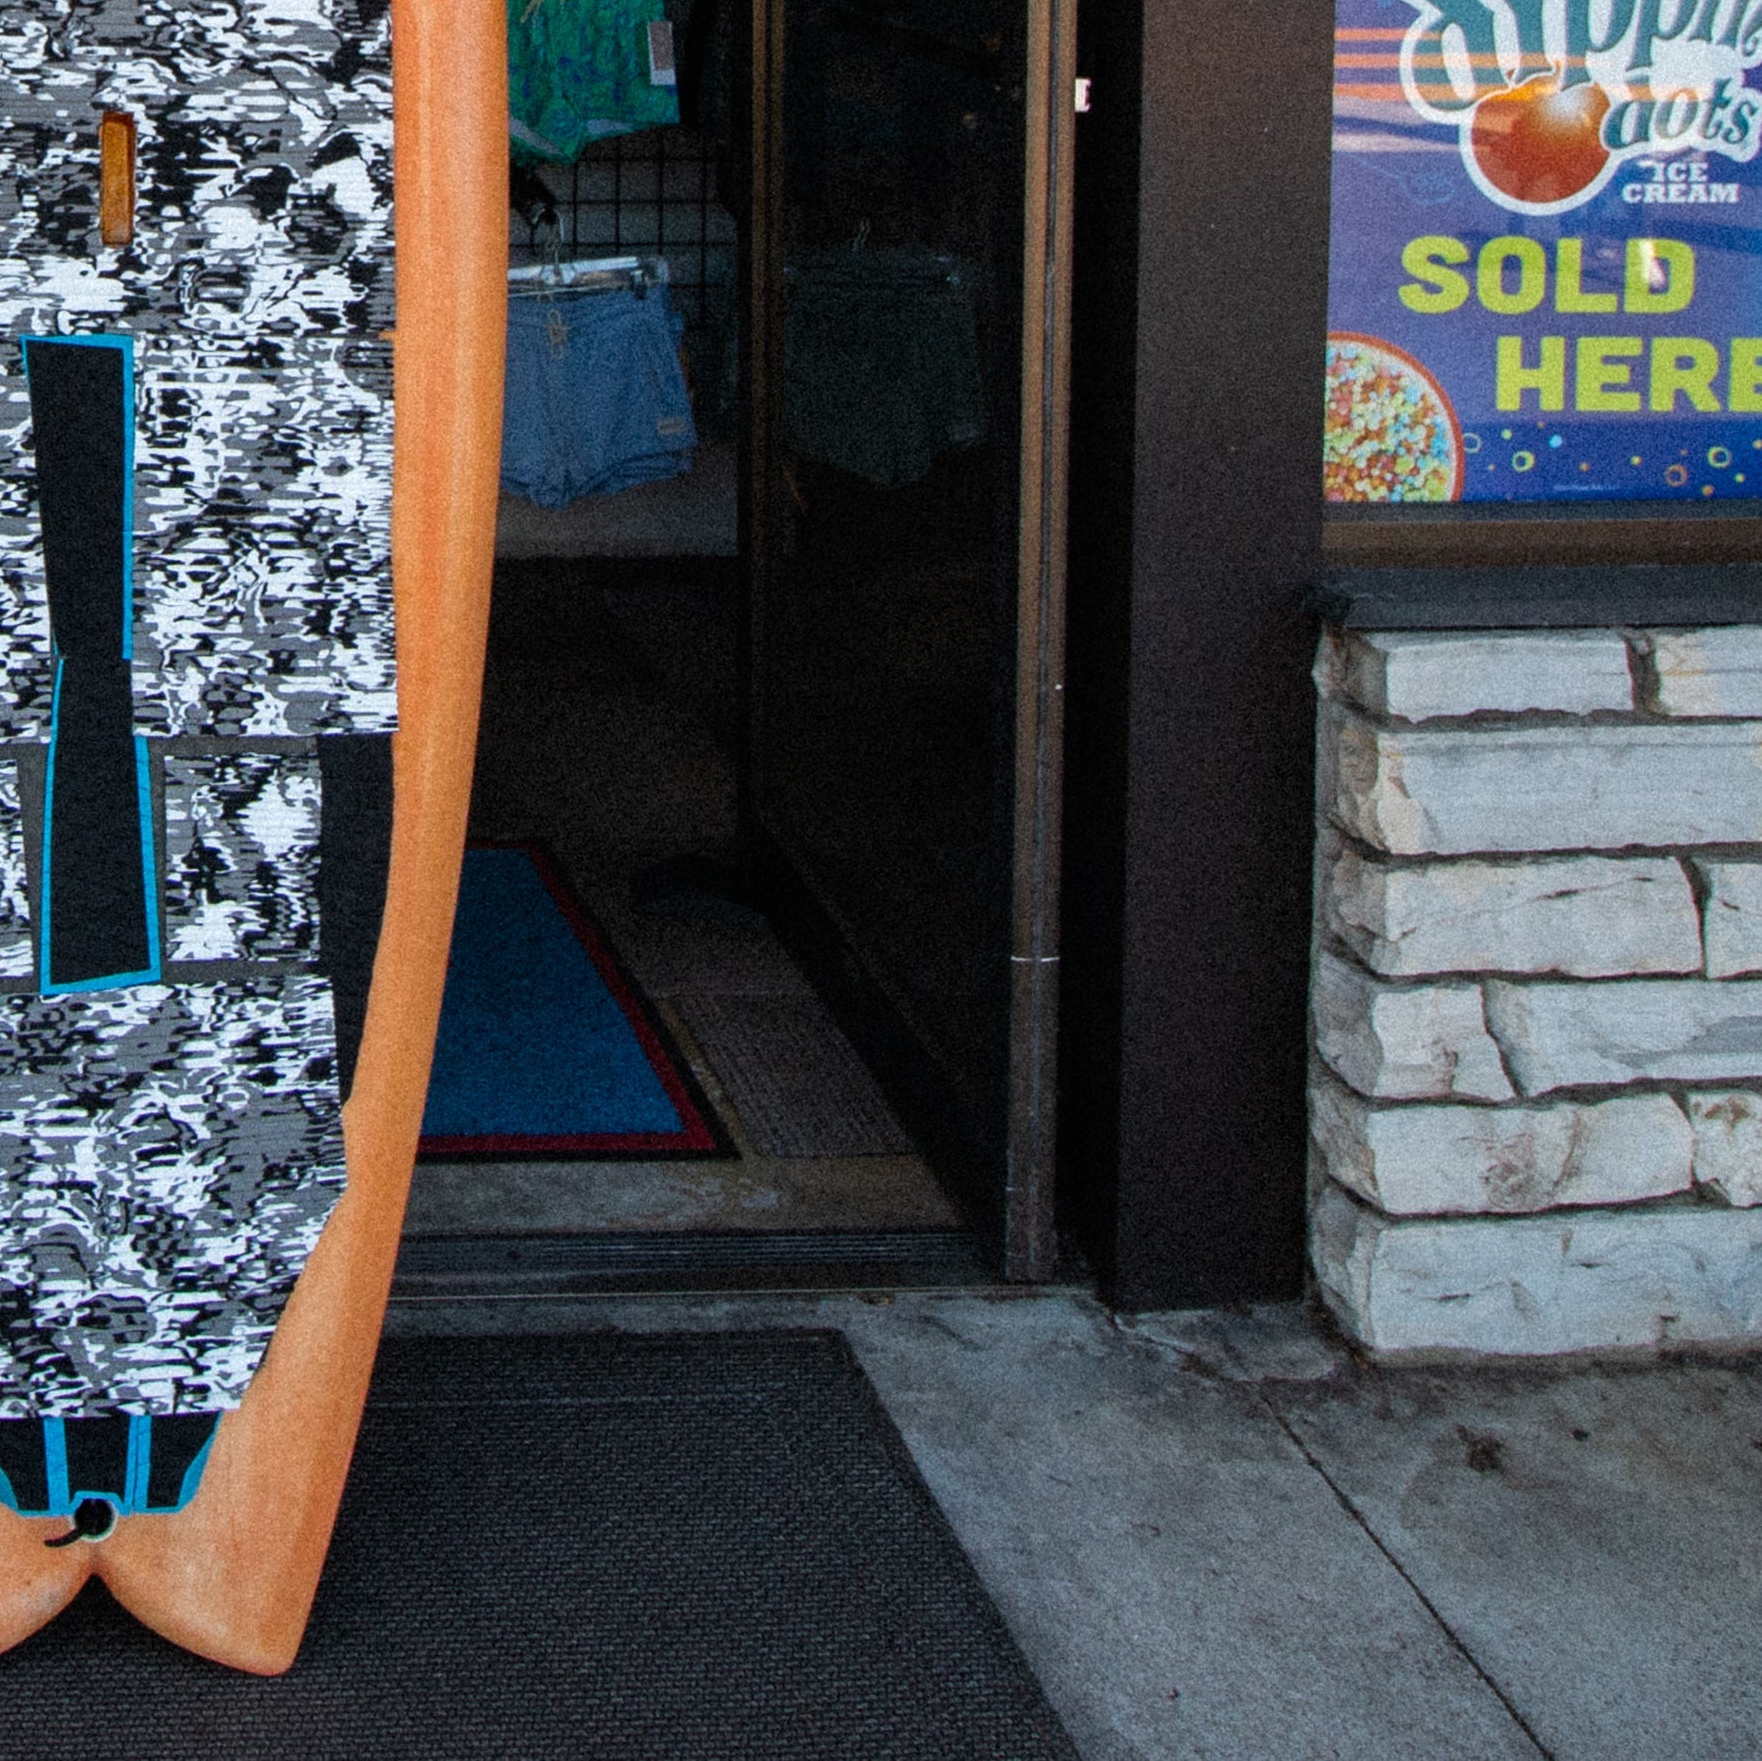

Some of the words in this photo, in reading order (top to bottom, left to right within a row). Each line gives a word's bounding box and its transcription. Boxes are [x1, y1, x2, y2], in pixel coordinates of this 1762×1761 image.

[1622, 183, 1739, 204] CREAM
[1649, 161, 1709, 182] ICE
[1398, 235, 1696, 314] SOLD
[1495, 336, 1762, 412] HERE
